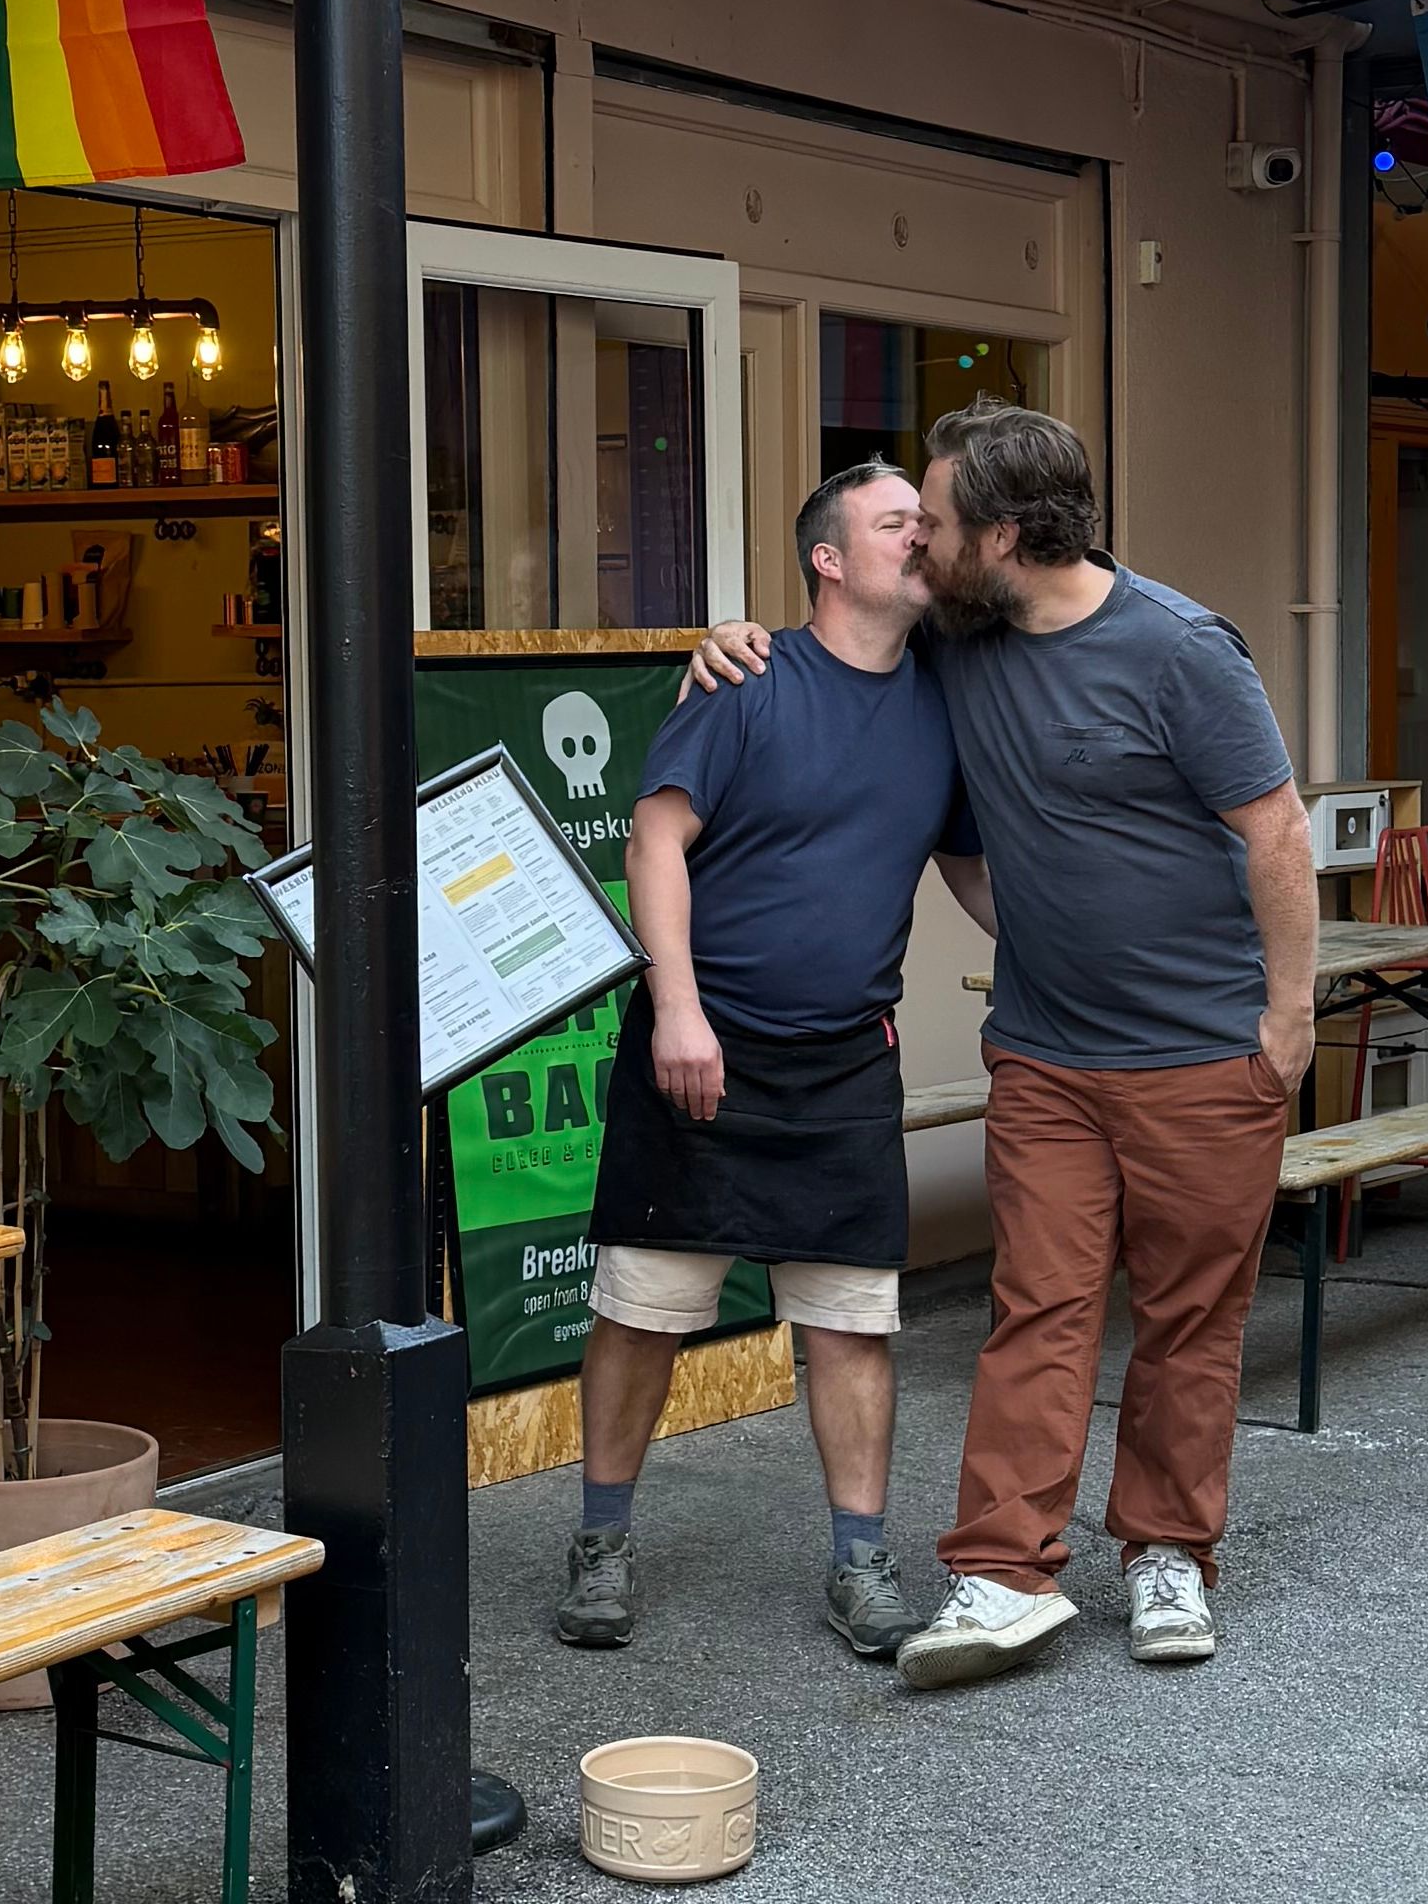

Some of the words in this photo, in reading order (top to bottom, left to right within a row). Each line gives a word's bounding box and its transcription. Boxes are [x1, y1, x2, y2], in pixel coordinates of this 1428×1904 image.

[560, 811, 633, 849] eysku
[523, 1294, 551, 1316] open
[553, 1287, 578, 1308] from
